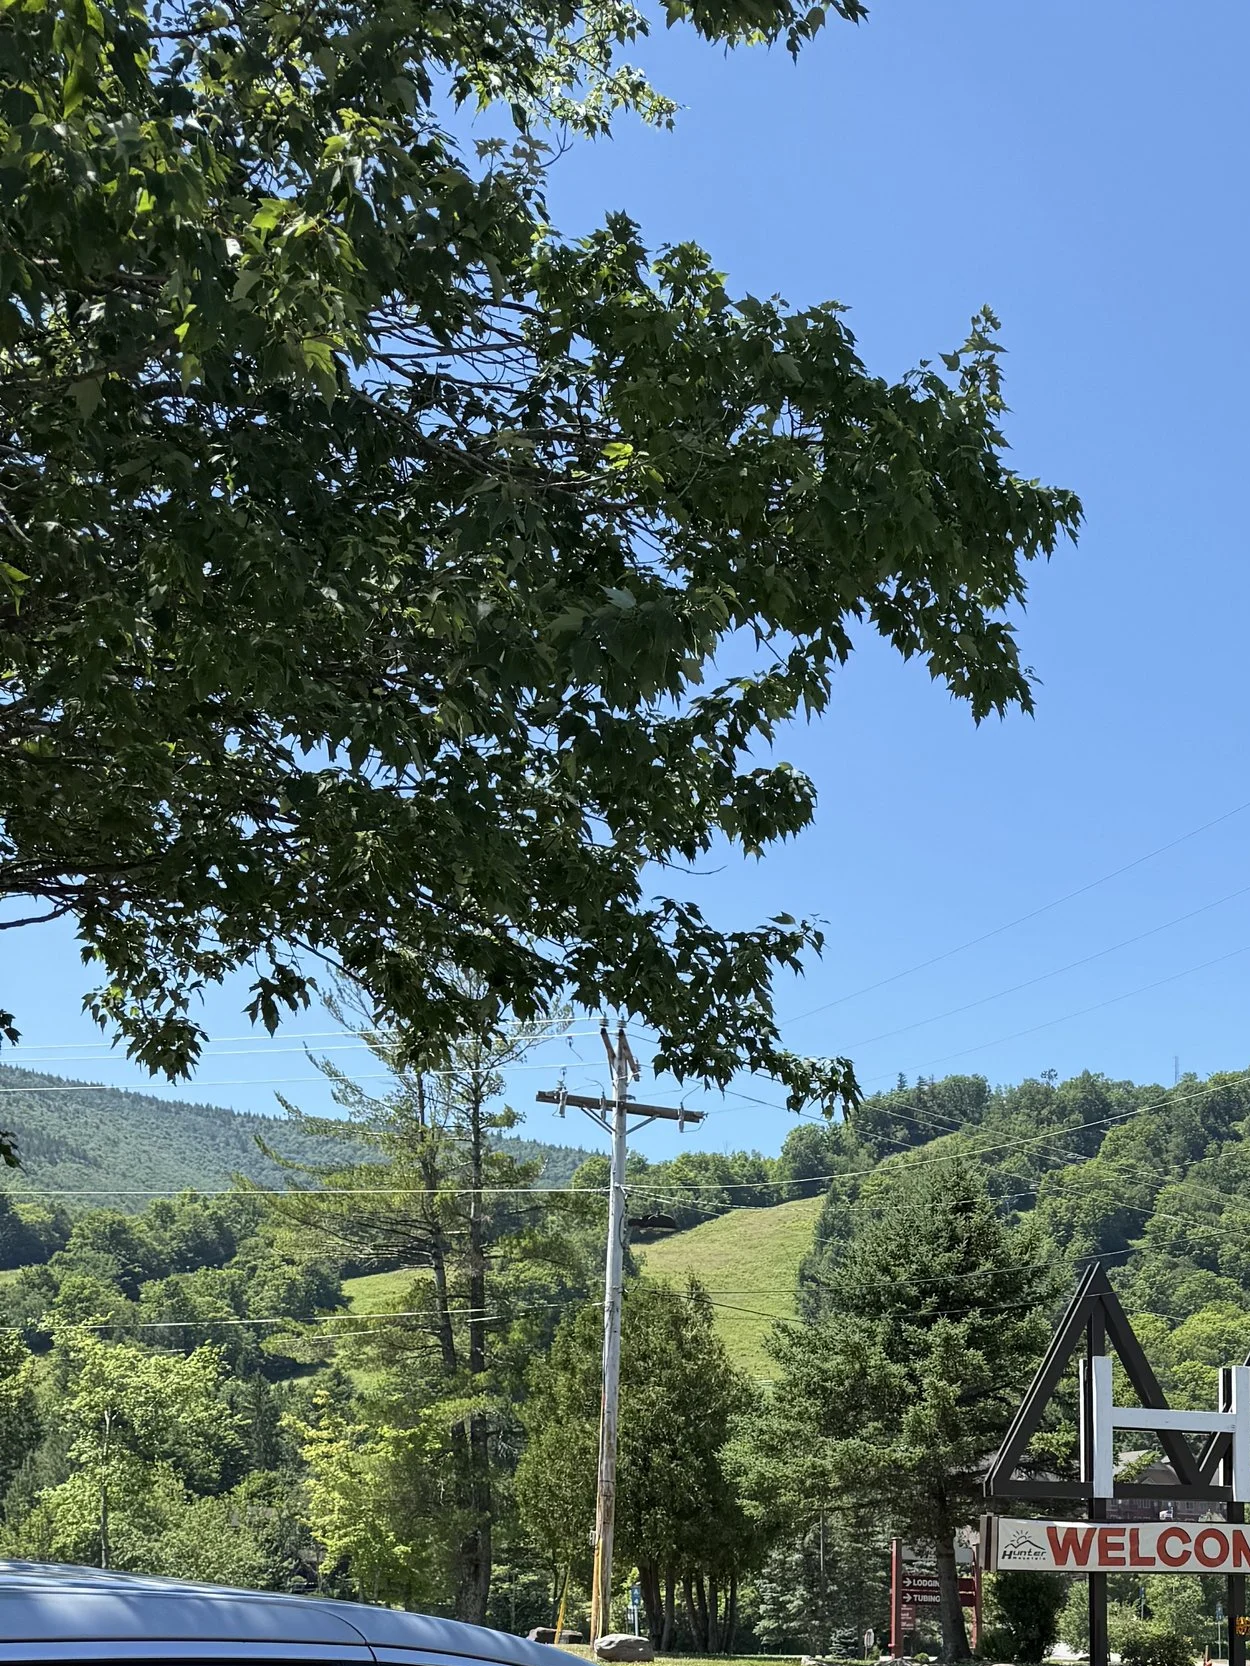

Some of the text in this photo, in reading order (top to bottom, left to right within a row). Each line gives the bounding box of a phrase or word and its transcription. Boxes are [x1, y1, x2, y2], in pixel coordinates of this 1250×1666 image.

[1001, 1548, 1047, 1559] Hunter
[912, 1578, 940, 1587] LODGIN
[913, 1594, 941, 1603] TUBING
